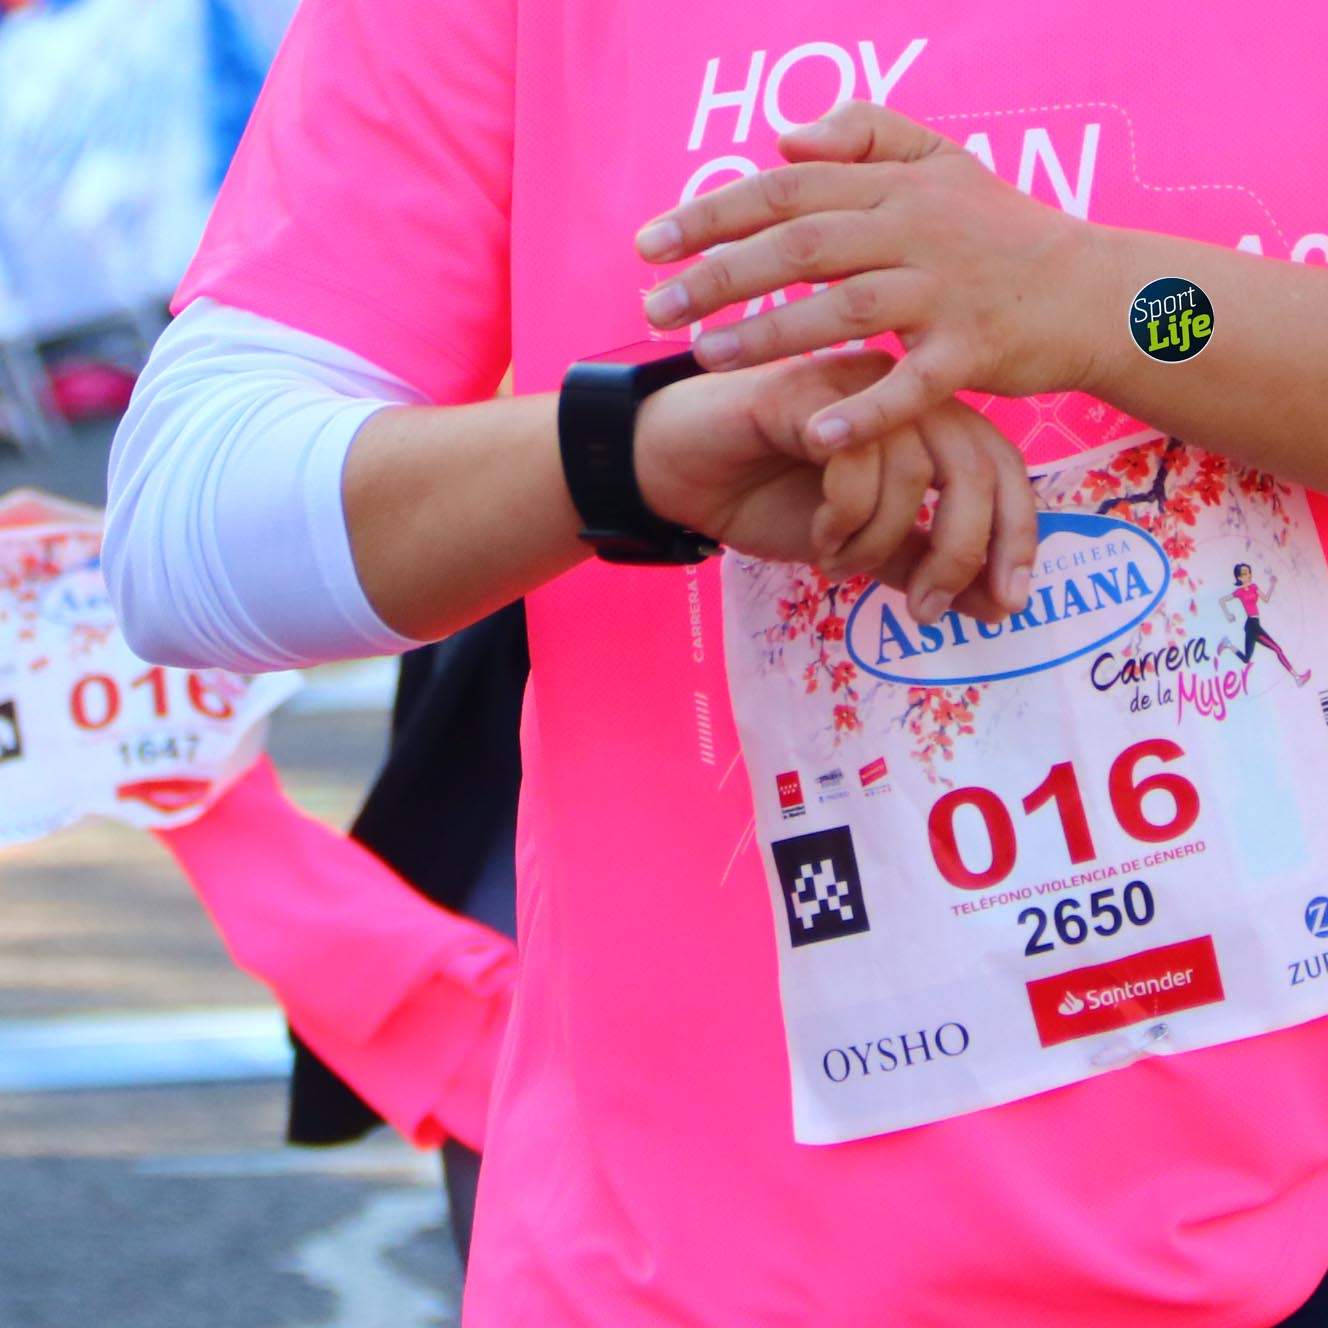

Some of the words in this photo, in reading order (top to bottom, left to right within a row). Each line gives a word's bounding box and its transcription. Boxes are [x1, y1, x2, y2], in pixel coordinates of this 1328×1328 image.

[687, 38, 928, 151] HOY
[688, 579, 705, 664] CARRERA
[1090, 637, 1210, 692] Carrera
[1130, 686, 1152, 713] de
[1157, 679, 1174, 706] la
[1177, 656, 1255, 726] Mujer
[928, 738, 1201, 891] 016
[951, 887, 1033, 917] TELÉFONO
[1034, 865, 1119, 896] VIOLENCIA
[1121, 858, 1142, 874] DE
[1144, 840, 1207, 869] GÉNERO
[1017, 880, 1156, 957] 2650
[1085, 968, 1194, 1010] Santander
[823, 1022, 970, 1083] OYSHO
